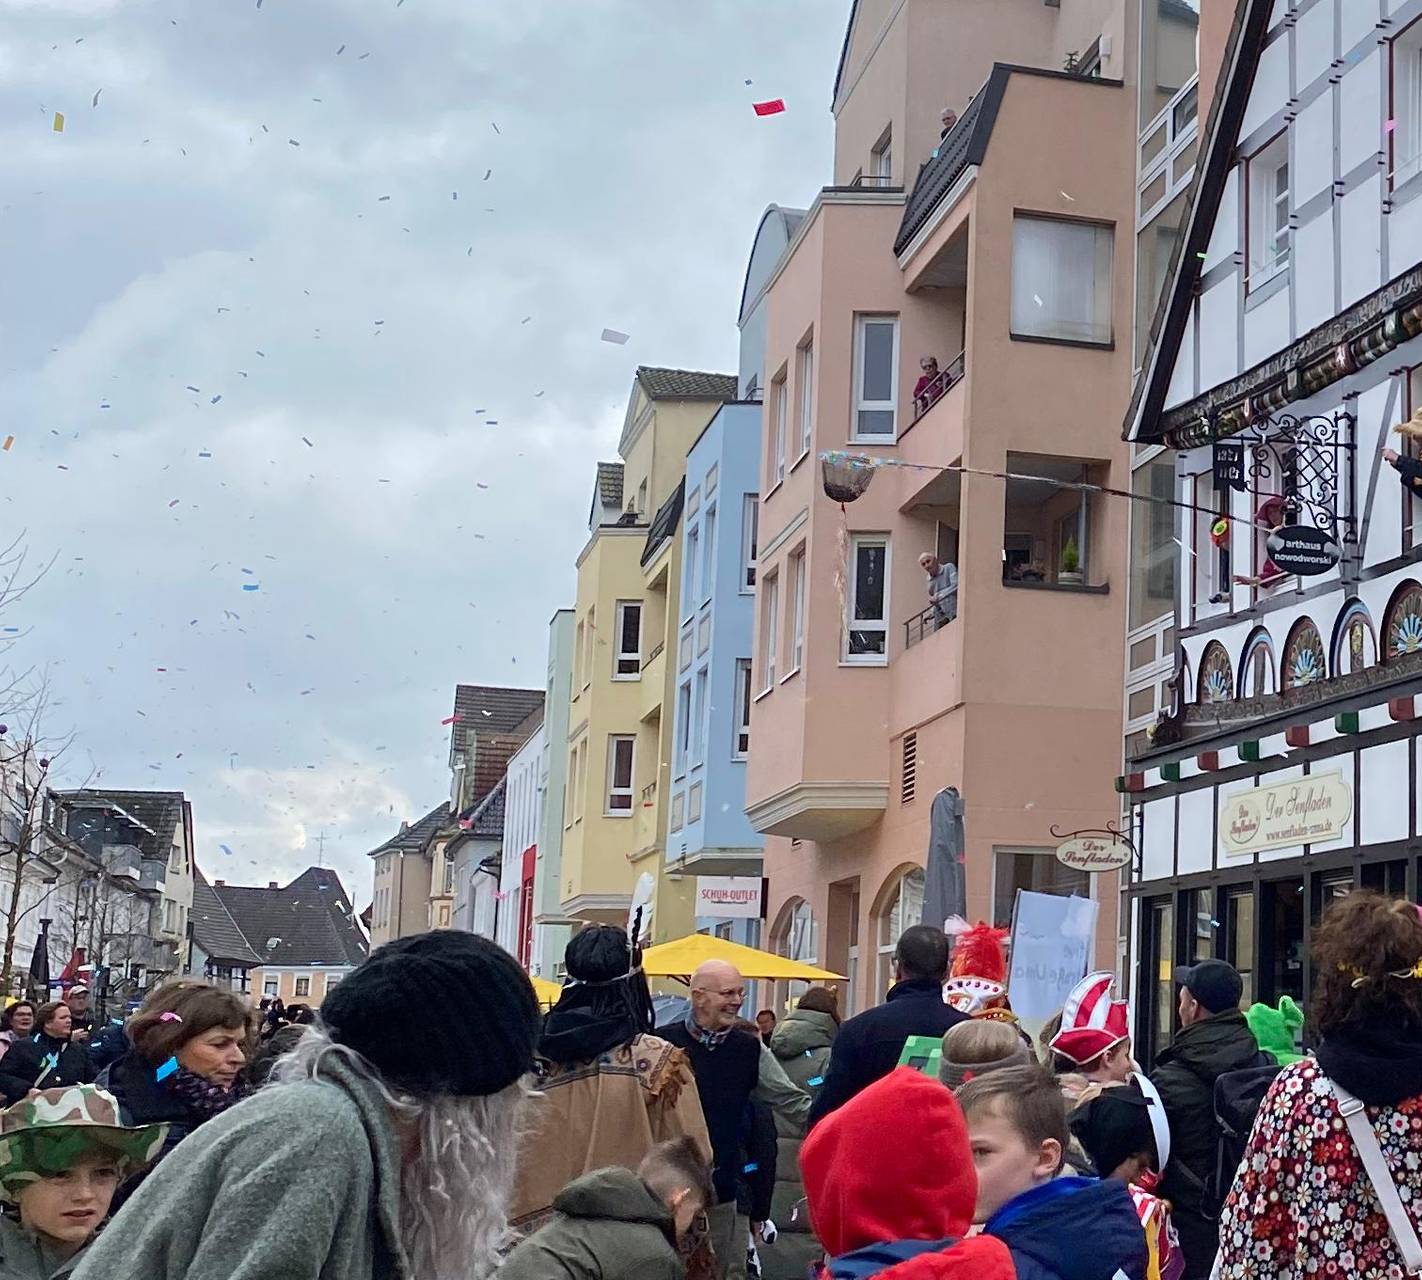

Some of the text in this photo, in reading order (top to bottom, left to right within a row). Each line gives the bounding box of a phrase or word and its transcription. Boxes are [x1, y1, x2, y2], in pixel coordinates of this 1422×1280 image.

[1285, 540, 1321, 550] arthaus
[1274, 553, 1331, 564] nowodworski
[1082, 840, 1106, 852] Der
[1062, 851, 1123, 867] Senfladen
[701, 888, 758, 900] SCHUH-OUTLET
